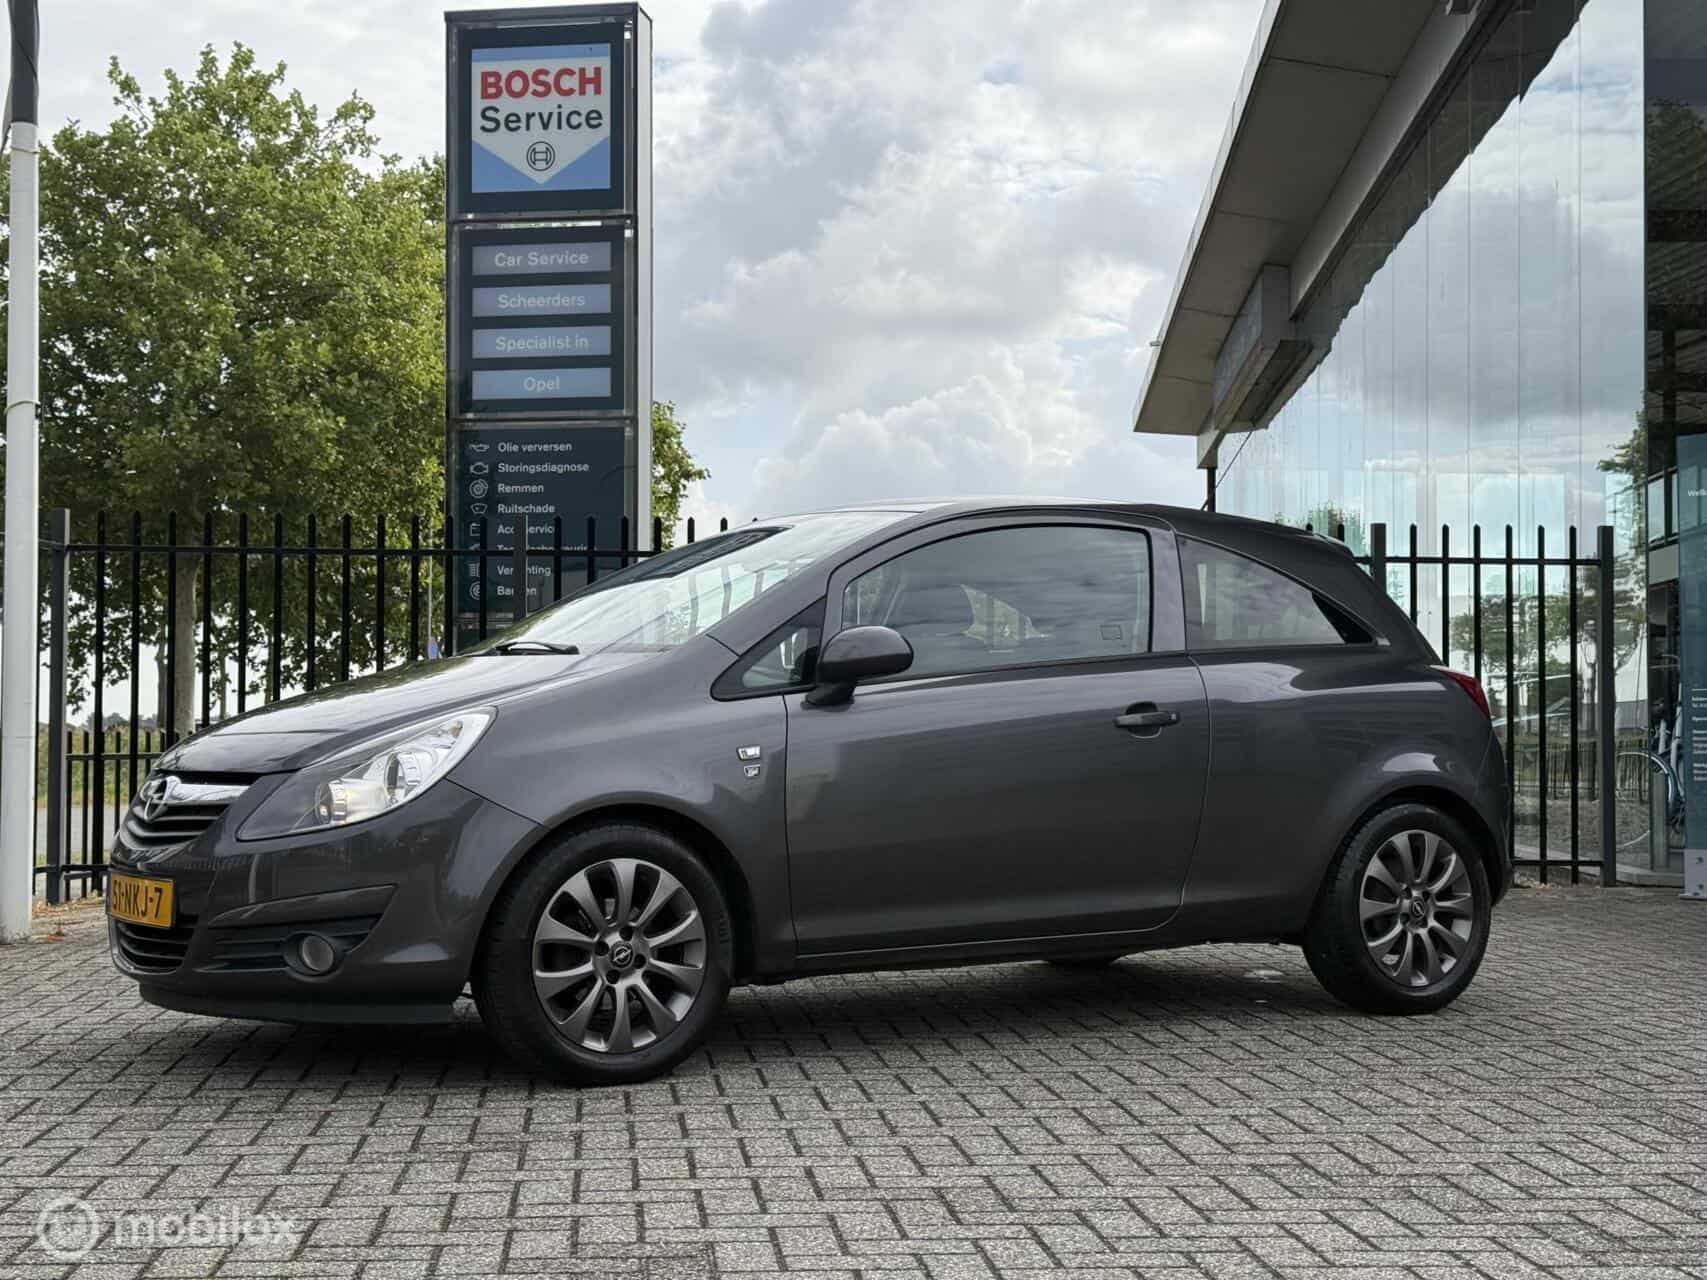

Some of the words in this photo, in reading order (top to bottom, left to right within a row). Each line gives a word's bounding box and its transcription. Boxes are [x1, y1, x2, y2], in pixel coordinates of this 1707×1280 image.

[480, 66, 602, 100] BOSCH
[480, 104, 603, 133] Service
[494, 252, 522, 267] Car
[528, 250, 589, 266] Service
[498, 293, 586, 309] Scheerders
[495, 334, 570, 353] Specialist
[523, 376, 560, 393] Opel
[498, 443, 519, 452] Olie
[521, 442, 572, 451] verversen
[498, 462, 589, 474] Storingsdiagnose
[498, 482, 544, 493] Remmen
[498, 503, 555, 513] Ruitschade
